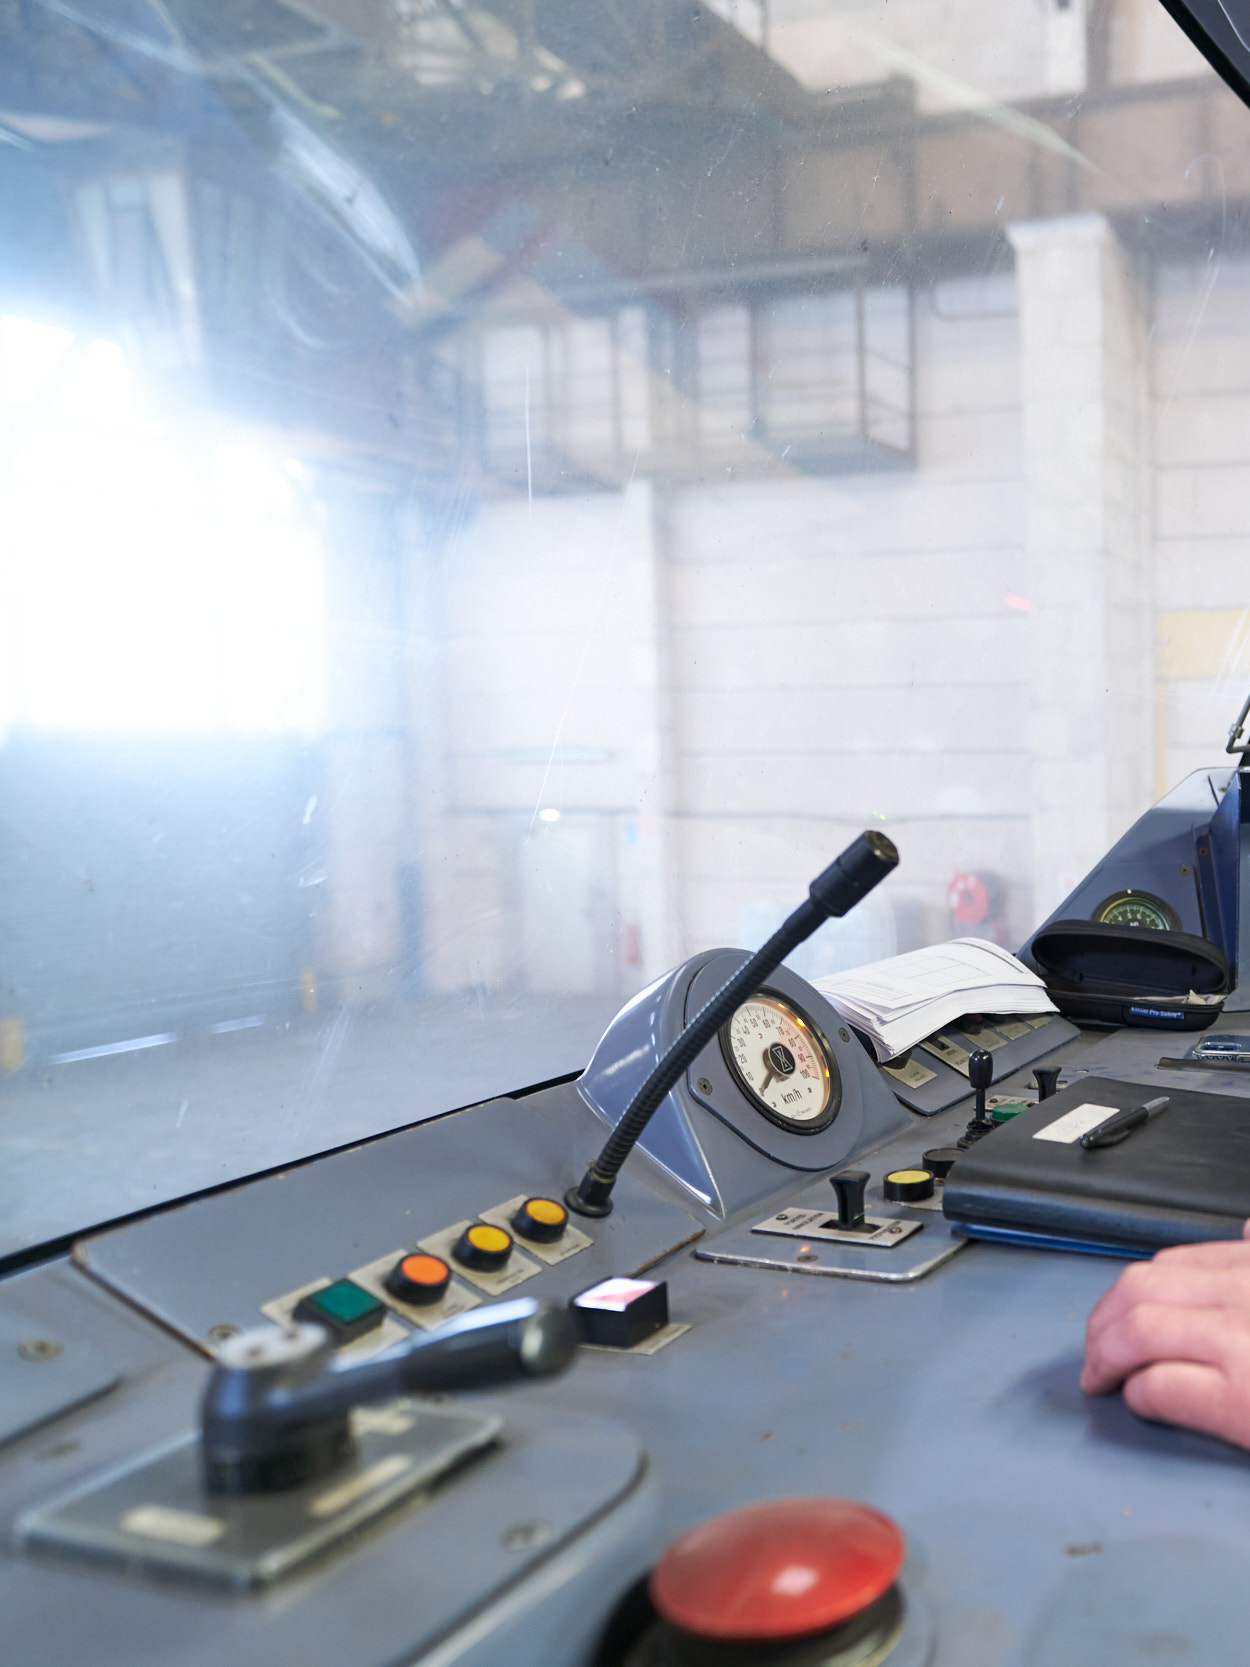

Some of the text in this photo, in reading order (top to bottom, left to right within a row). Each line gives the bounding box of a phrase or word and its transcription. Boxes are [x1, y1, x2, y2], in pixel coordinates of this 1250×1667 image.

[749, 1018, 759, 1028] 50
[762, 1019, 771, 1029] 60
[741, 1025, 751, 1035] 40
[775, 1026, 785, 1036] 70
[737, 1037, 746, 1048] 30
[787, 1037, 797, 1048] 80
[738, 1053, 747, 1064] 20
[797, 1053, 806, 1063] 90
[800, 1069, 811, 1079] 100
[780, 1088, 803, 1105] km/h
